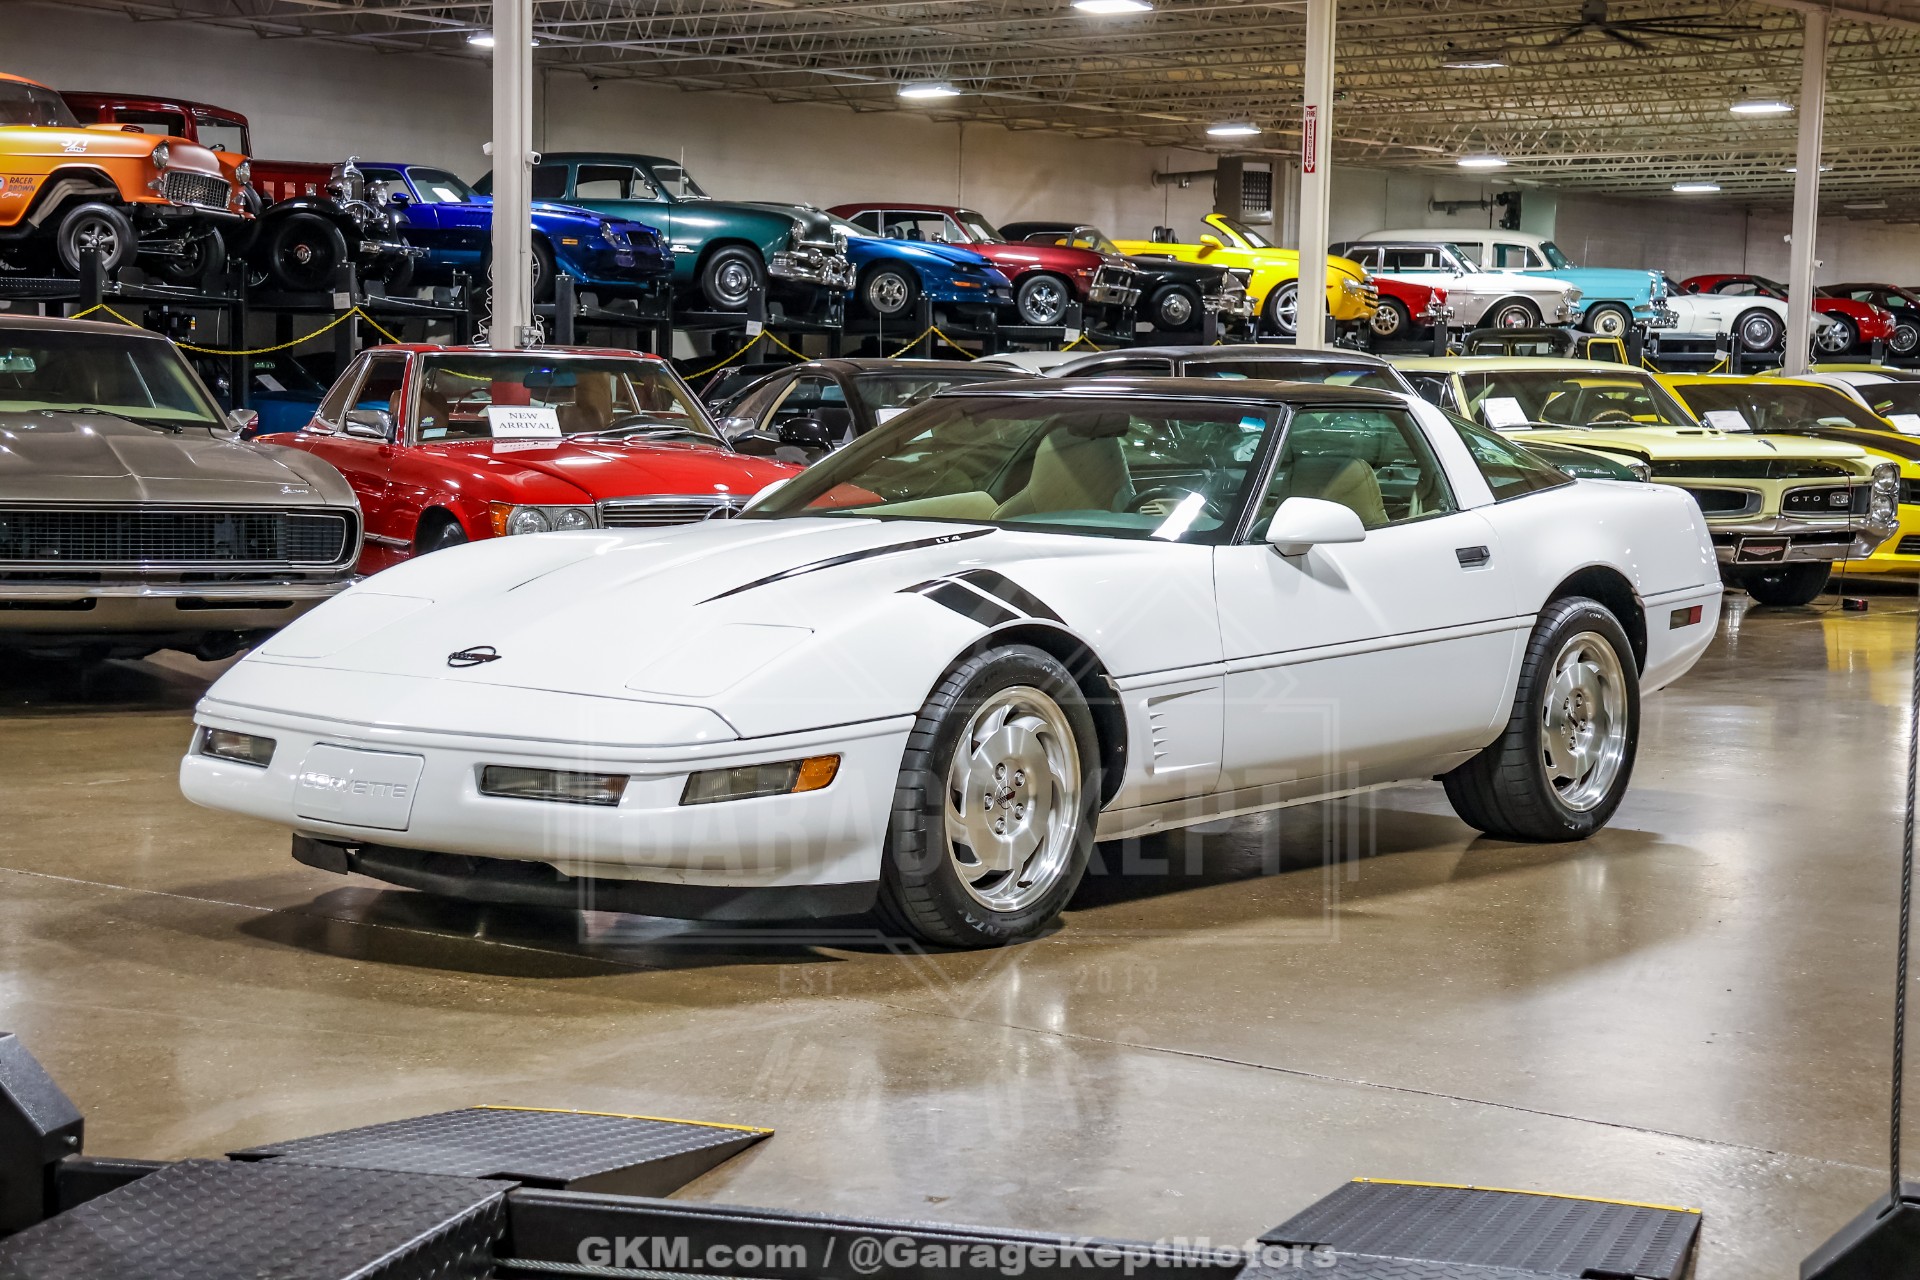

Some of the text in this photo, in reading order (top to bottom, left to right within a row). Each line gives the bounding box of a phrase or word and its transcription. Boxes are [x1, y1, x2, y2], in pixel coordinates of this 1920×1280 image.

[1306, 110, 1316, 118] FIRE
[9, 176, 34, 185] RACER
[8, 184, 36, 193] BROWN
[508, 412, 538, 420] NEW
[499, 421, 554, 430] ARRIVAL
[1791, 495, 1821, 503] GTO
[935, 535, 962, 544] LT4
[302, 771, 409, 799] CORVETTE
